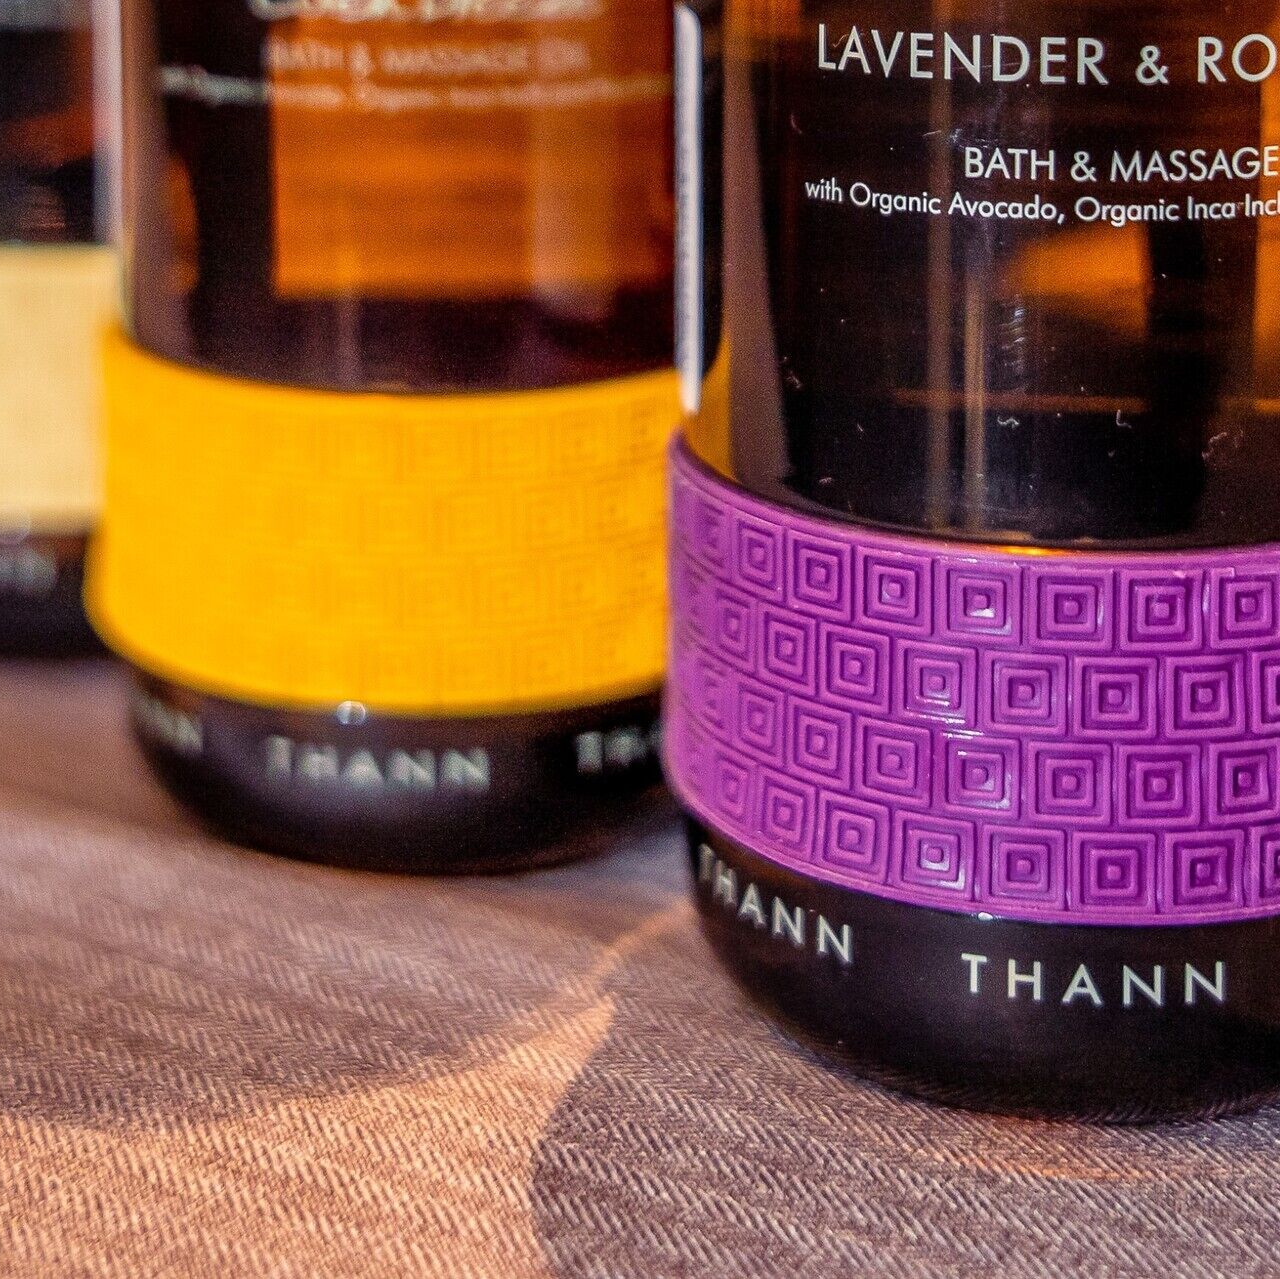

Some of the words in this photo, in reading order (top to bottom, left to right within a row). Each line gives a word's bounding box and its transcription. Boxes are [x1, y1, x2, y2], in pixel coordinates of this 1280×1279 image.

[818, 23, 1109, 85] LAVENDER
[1135, 45, 1169, 86] &
[964, 146, 1055, 181] BATH
[1070, 151, 1097, 182] &
[1110, 145, 1280, 182] MASSAGE
[805, 177, 842, 203] with
[849, 182, 941, 216] Organic
[947, 191, 1065, 224] Avocado,
[1074, 196, 1179, 228] Organic
[267, 734, 491, 792] THANN
[699, 842, 852, 964] THANN
[960, 952, 1224, 1007] THANN
